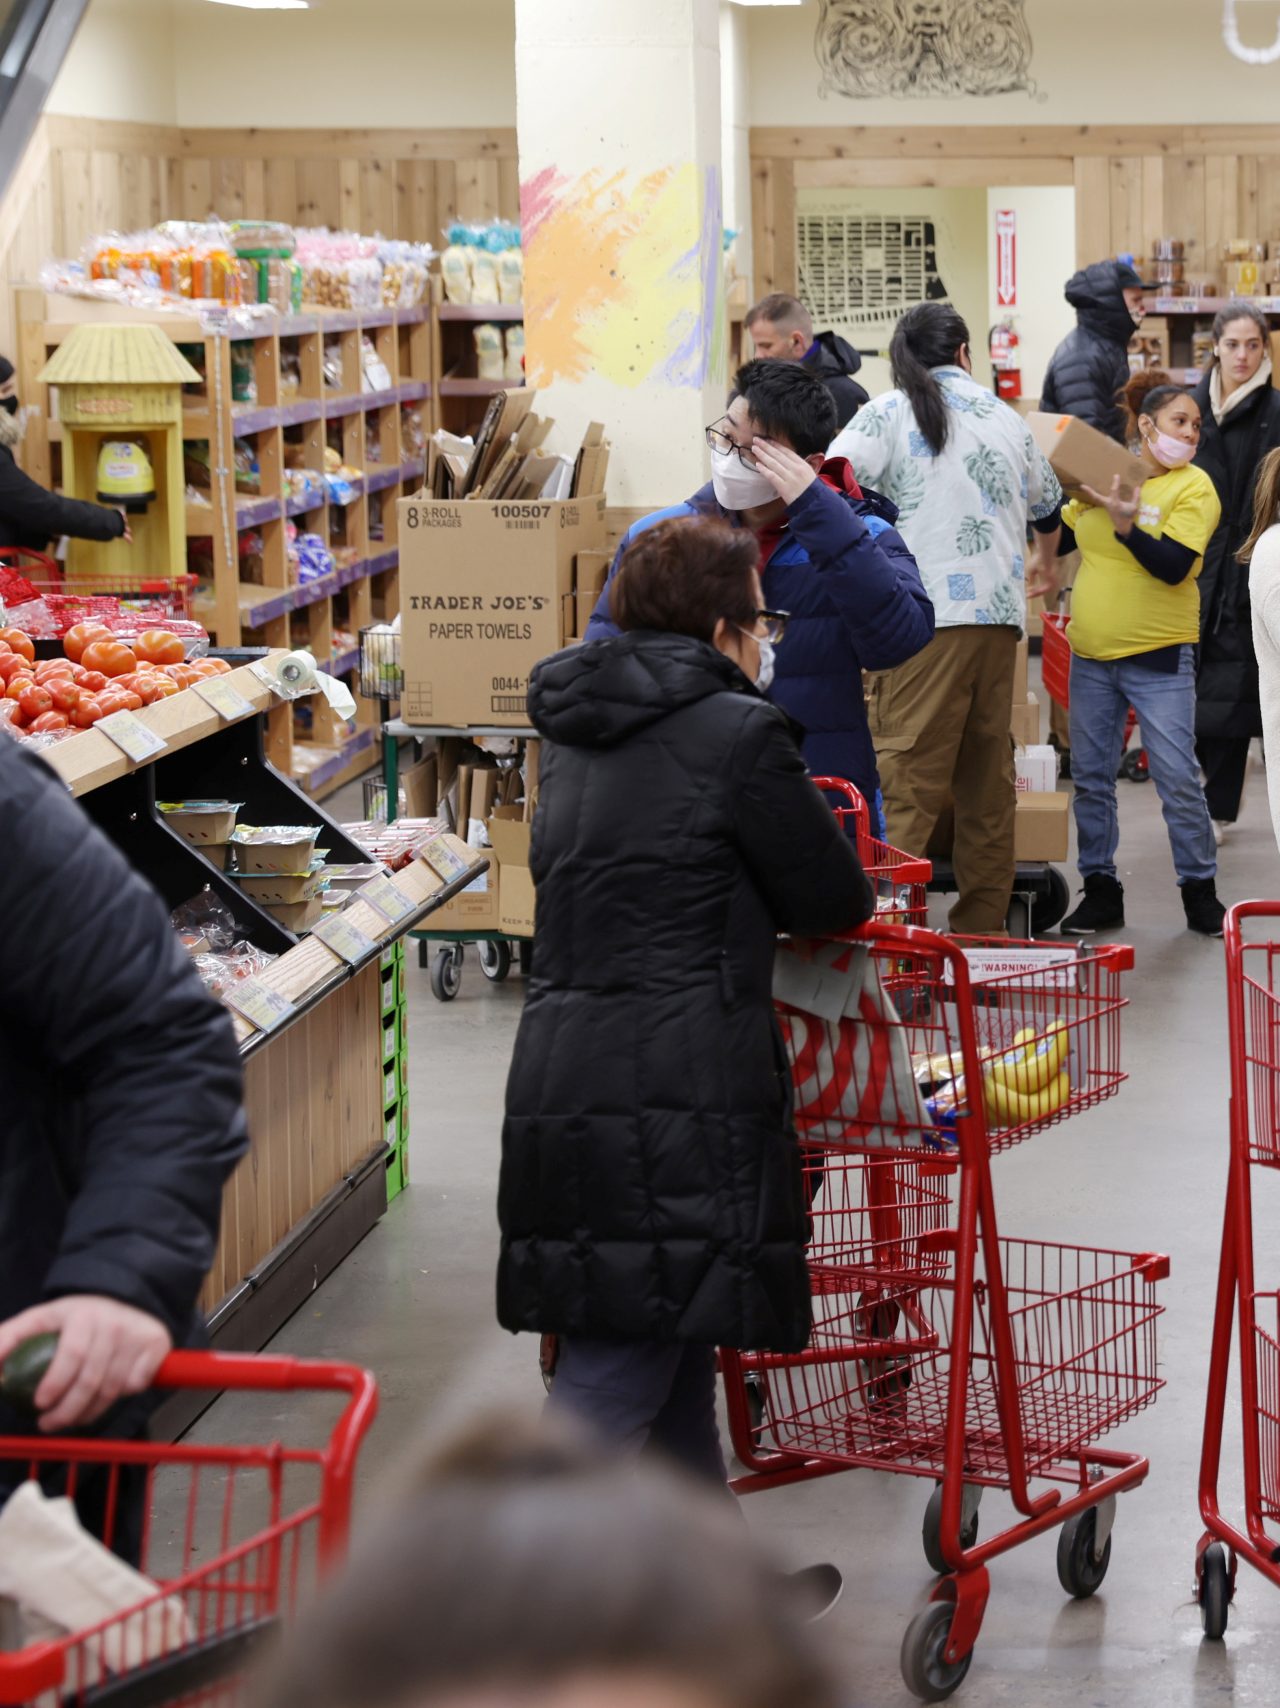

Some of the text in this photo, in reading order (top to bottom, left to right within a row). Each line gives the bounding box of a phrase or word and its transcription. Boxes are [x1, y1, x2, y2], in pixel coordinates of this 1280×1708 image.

[407, 507, 419, 529] 8
[422, 508, 461, 519] 3-ROLL
[491, 506, 551, 518] 100507
[559, 507, 566, 528] 8
[422, 518, 462, 529] PACKAGES
[409, 595, 545, 610] TRADER JOE'S
[429, 623, 532, 640] PAPER TOWELS
